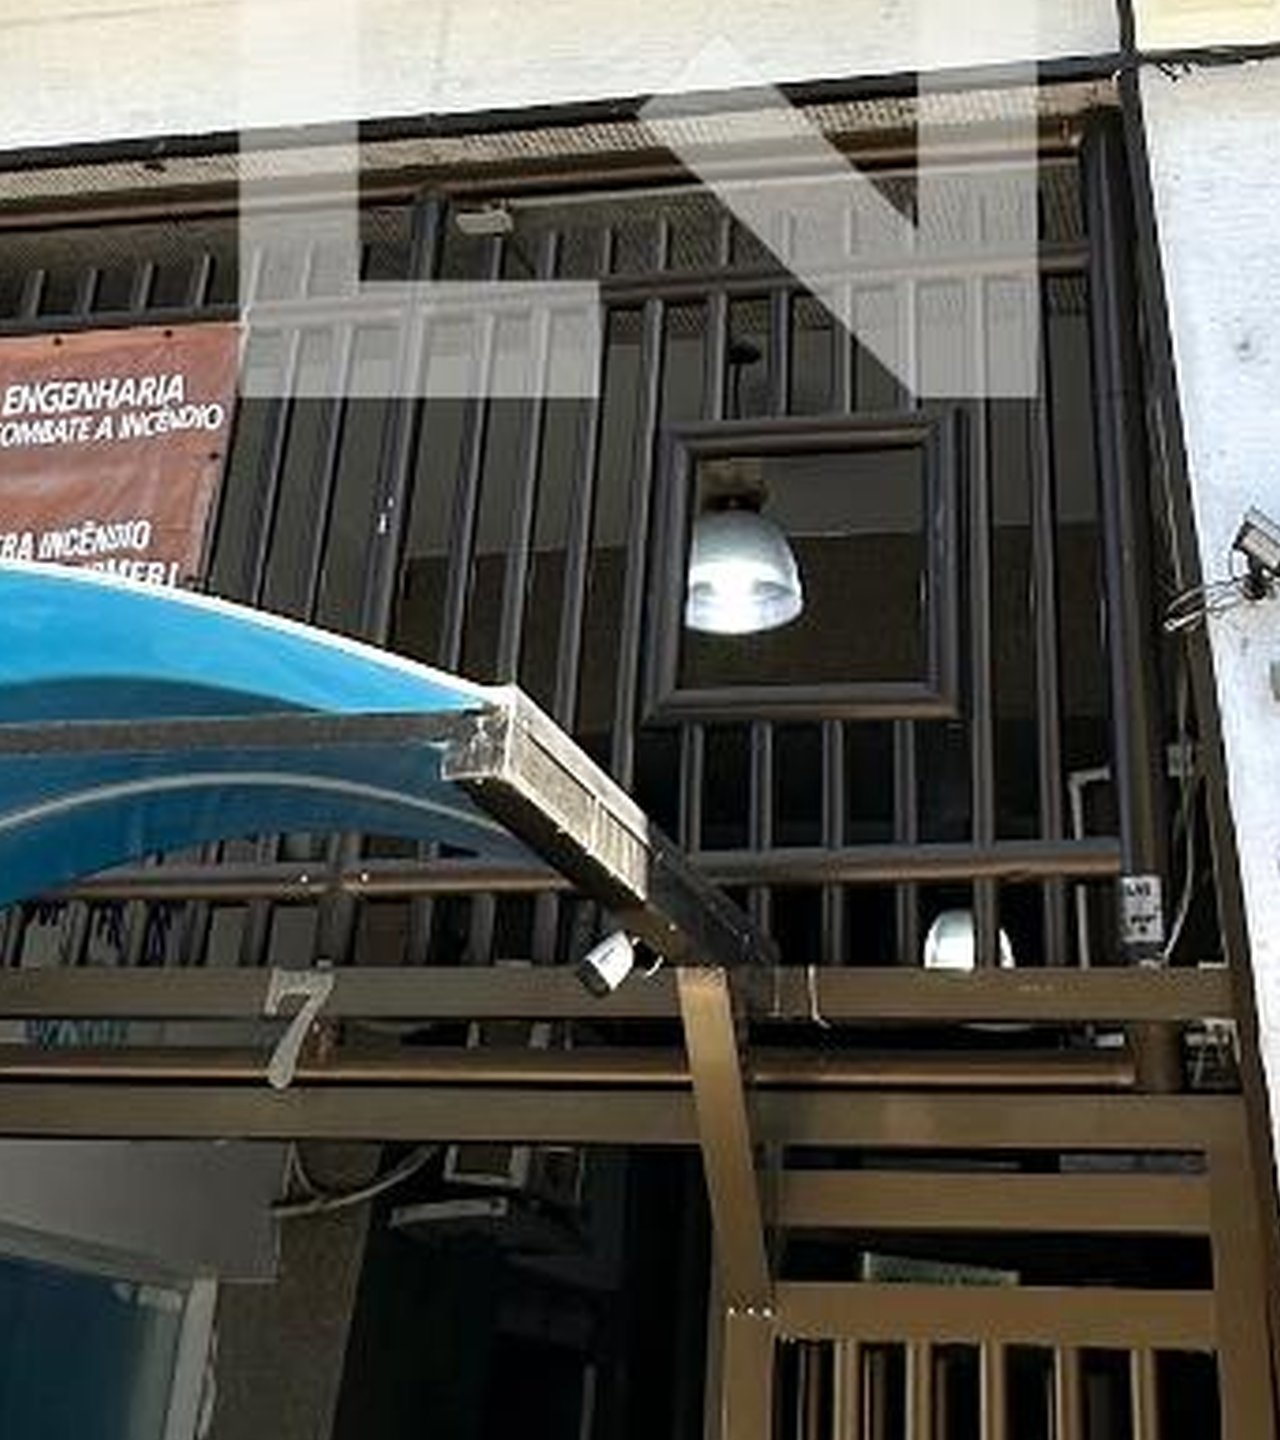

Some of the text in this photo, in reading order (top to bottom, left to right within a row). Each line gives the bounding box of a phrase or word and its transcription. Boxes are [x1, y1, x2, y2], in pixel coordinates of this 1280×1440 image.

[2, 374, 185, 416] ENGENHARIA
[94, 416, 113, 441] A
[38, 520, 152, 559] INCÊNDIO
[263, 967, 335, 1088] 7
